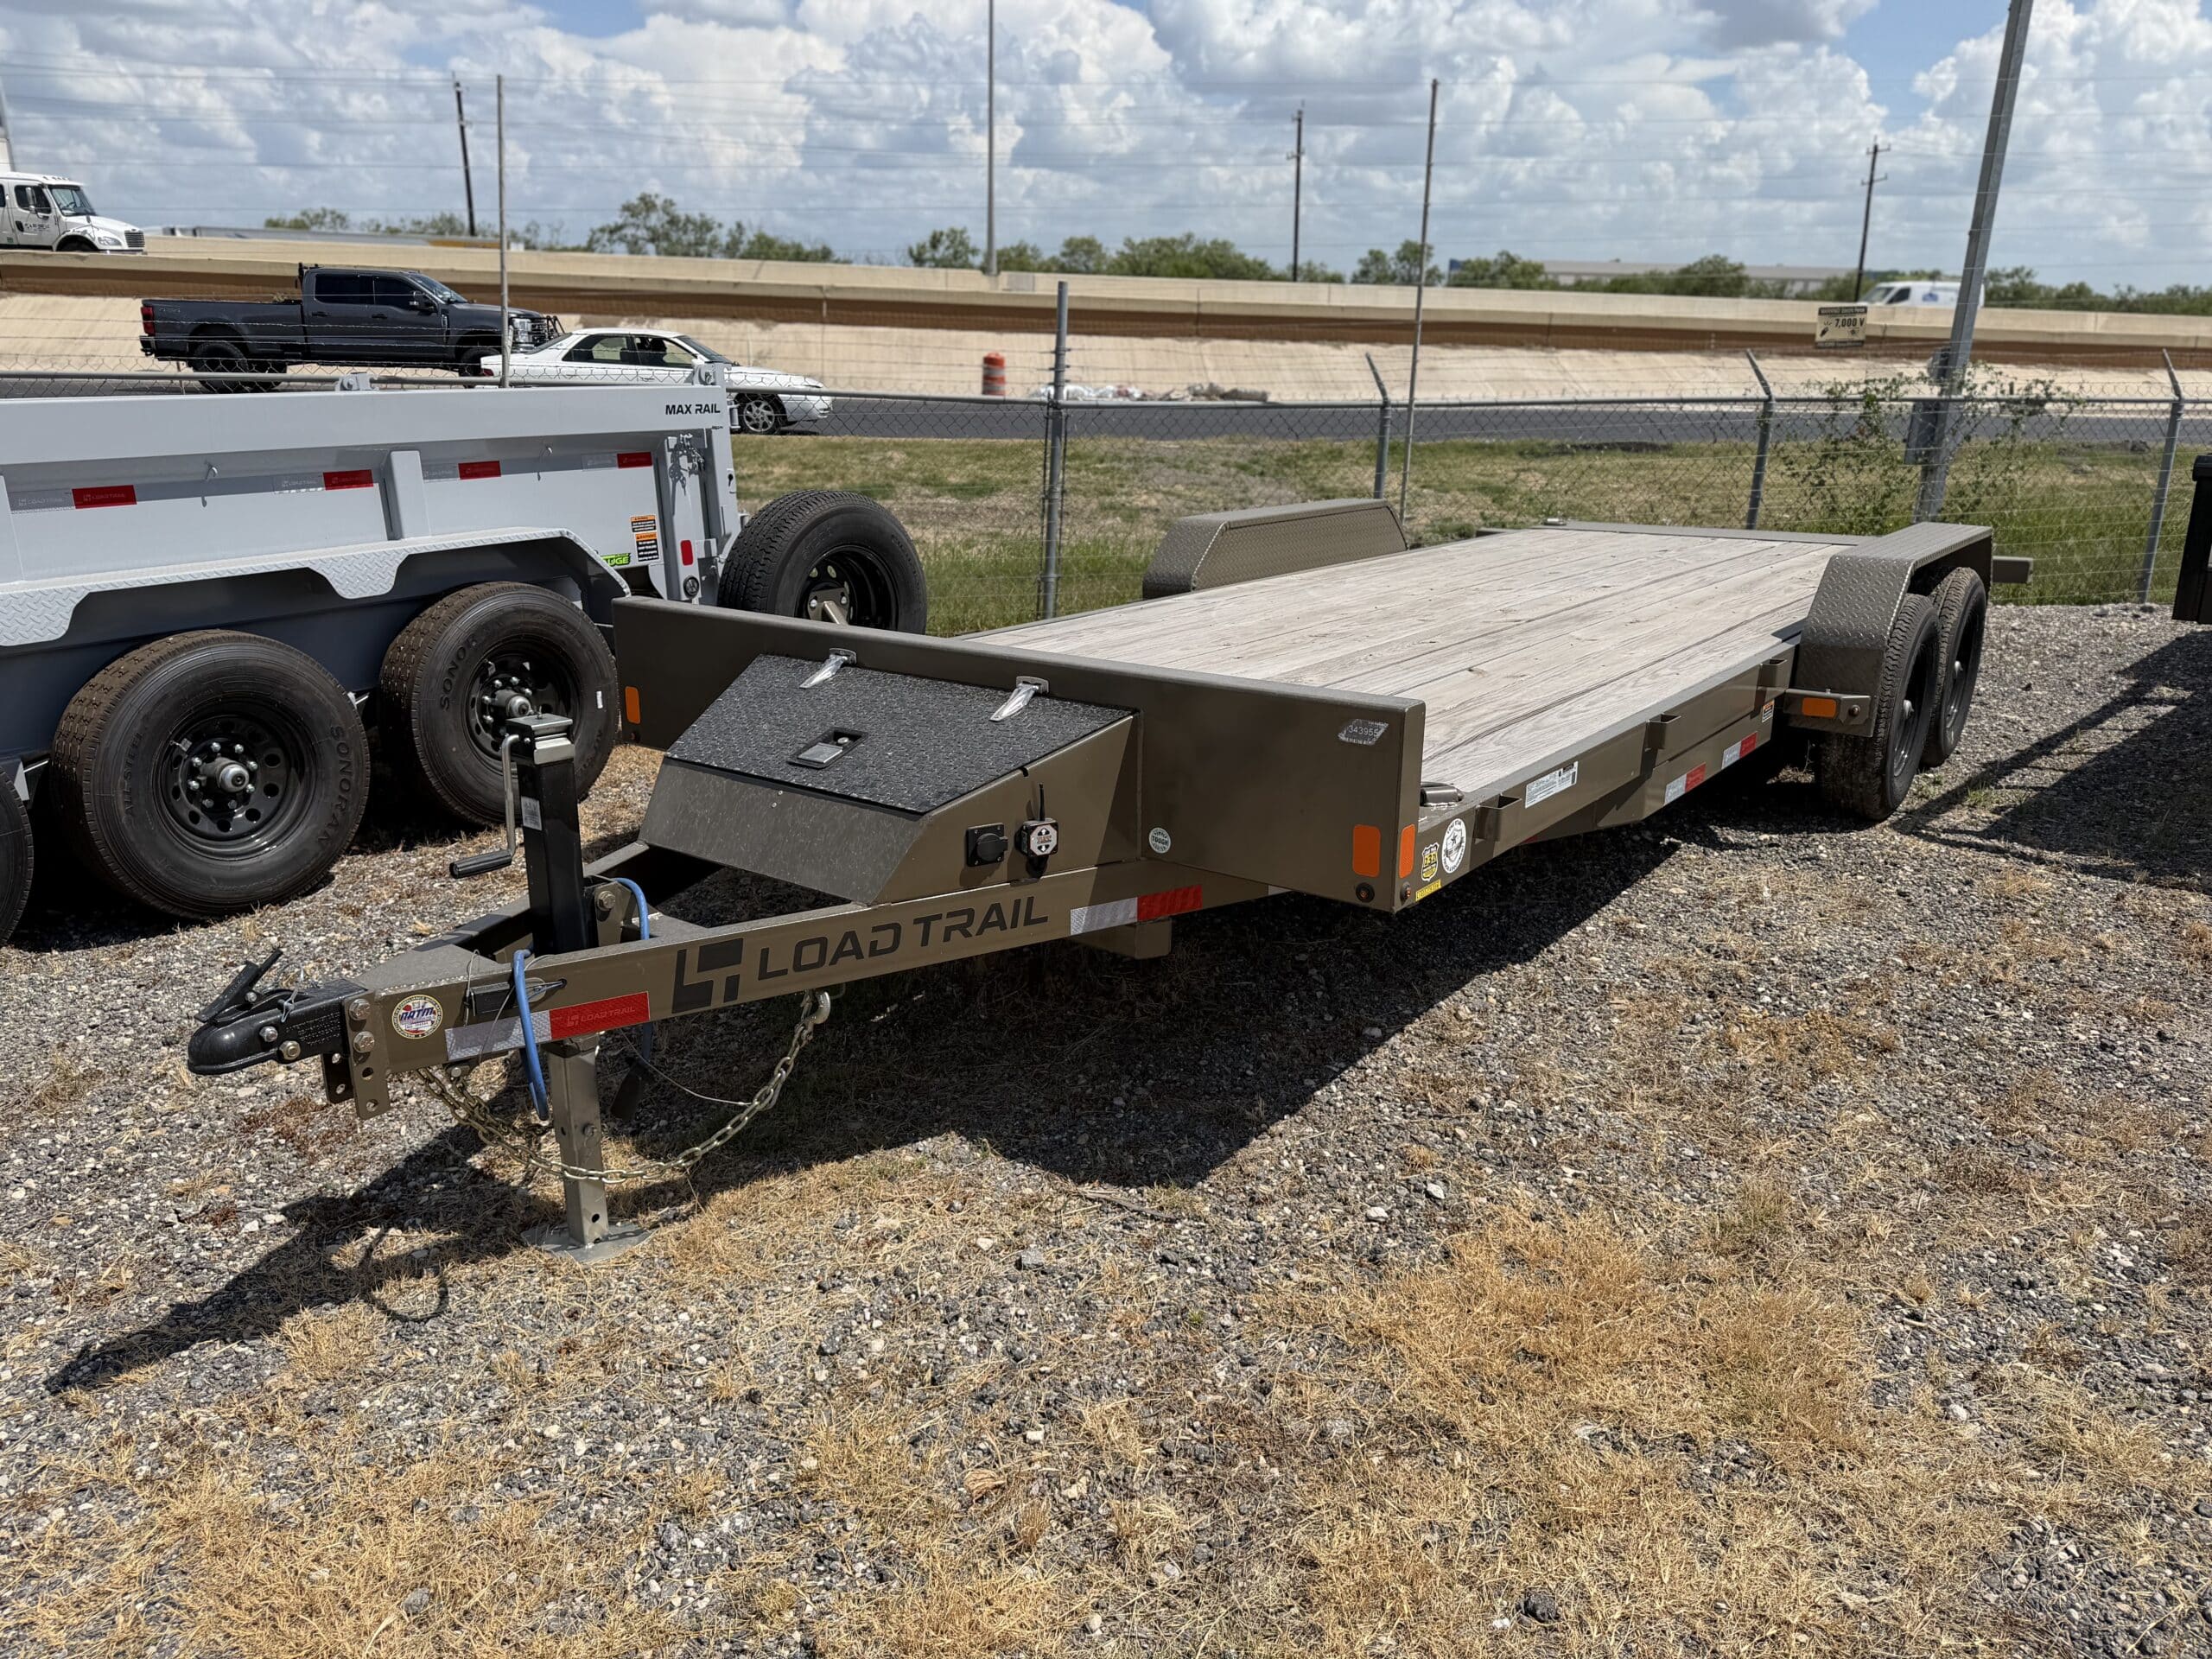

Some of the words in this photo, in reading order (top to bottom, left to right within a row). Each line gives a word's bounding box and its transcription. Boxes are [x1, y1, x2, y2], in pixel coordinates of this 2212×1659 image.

[1834, 318, 1857, 328] 7,000
[1859, 317, 1865, 327] V
[665, 404, 692, 415] MAX
[695, 404, 721, 414] RAIL
[758, 922, 902, 982] LOAD
[912, 896, 1049, 947] TRAIL
